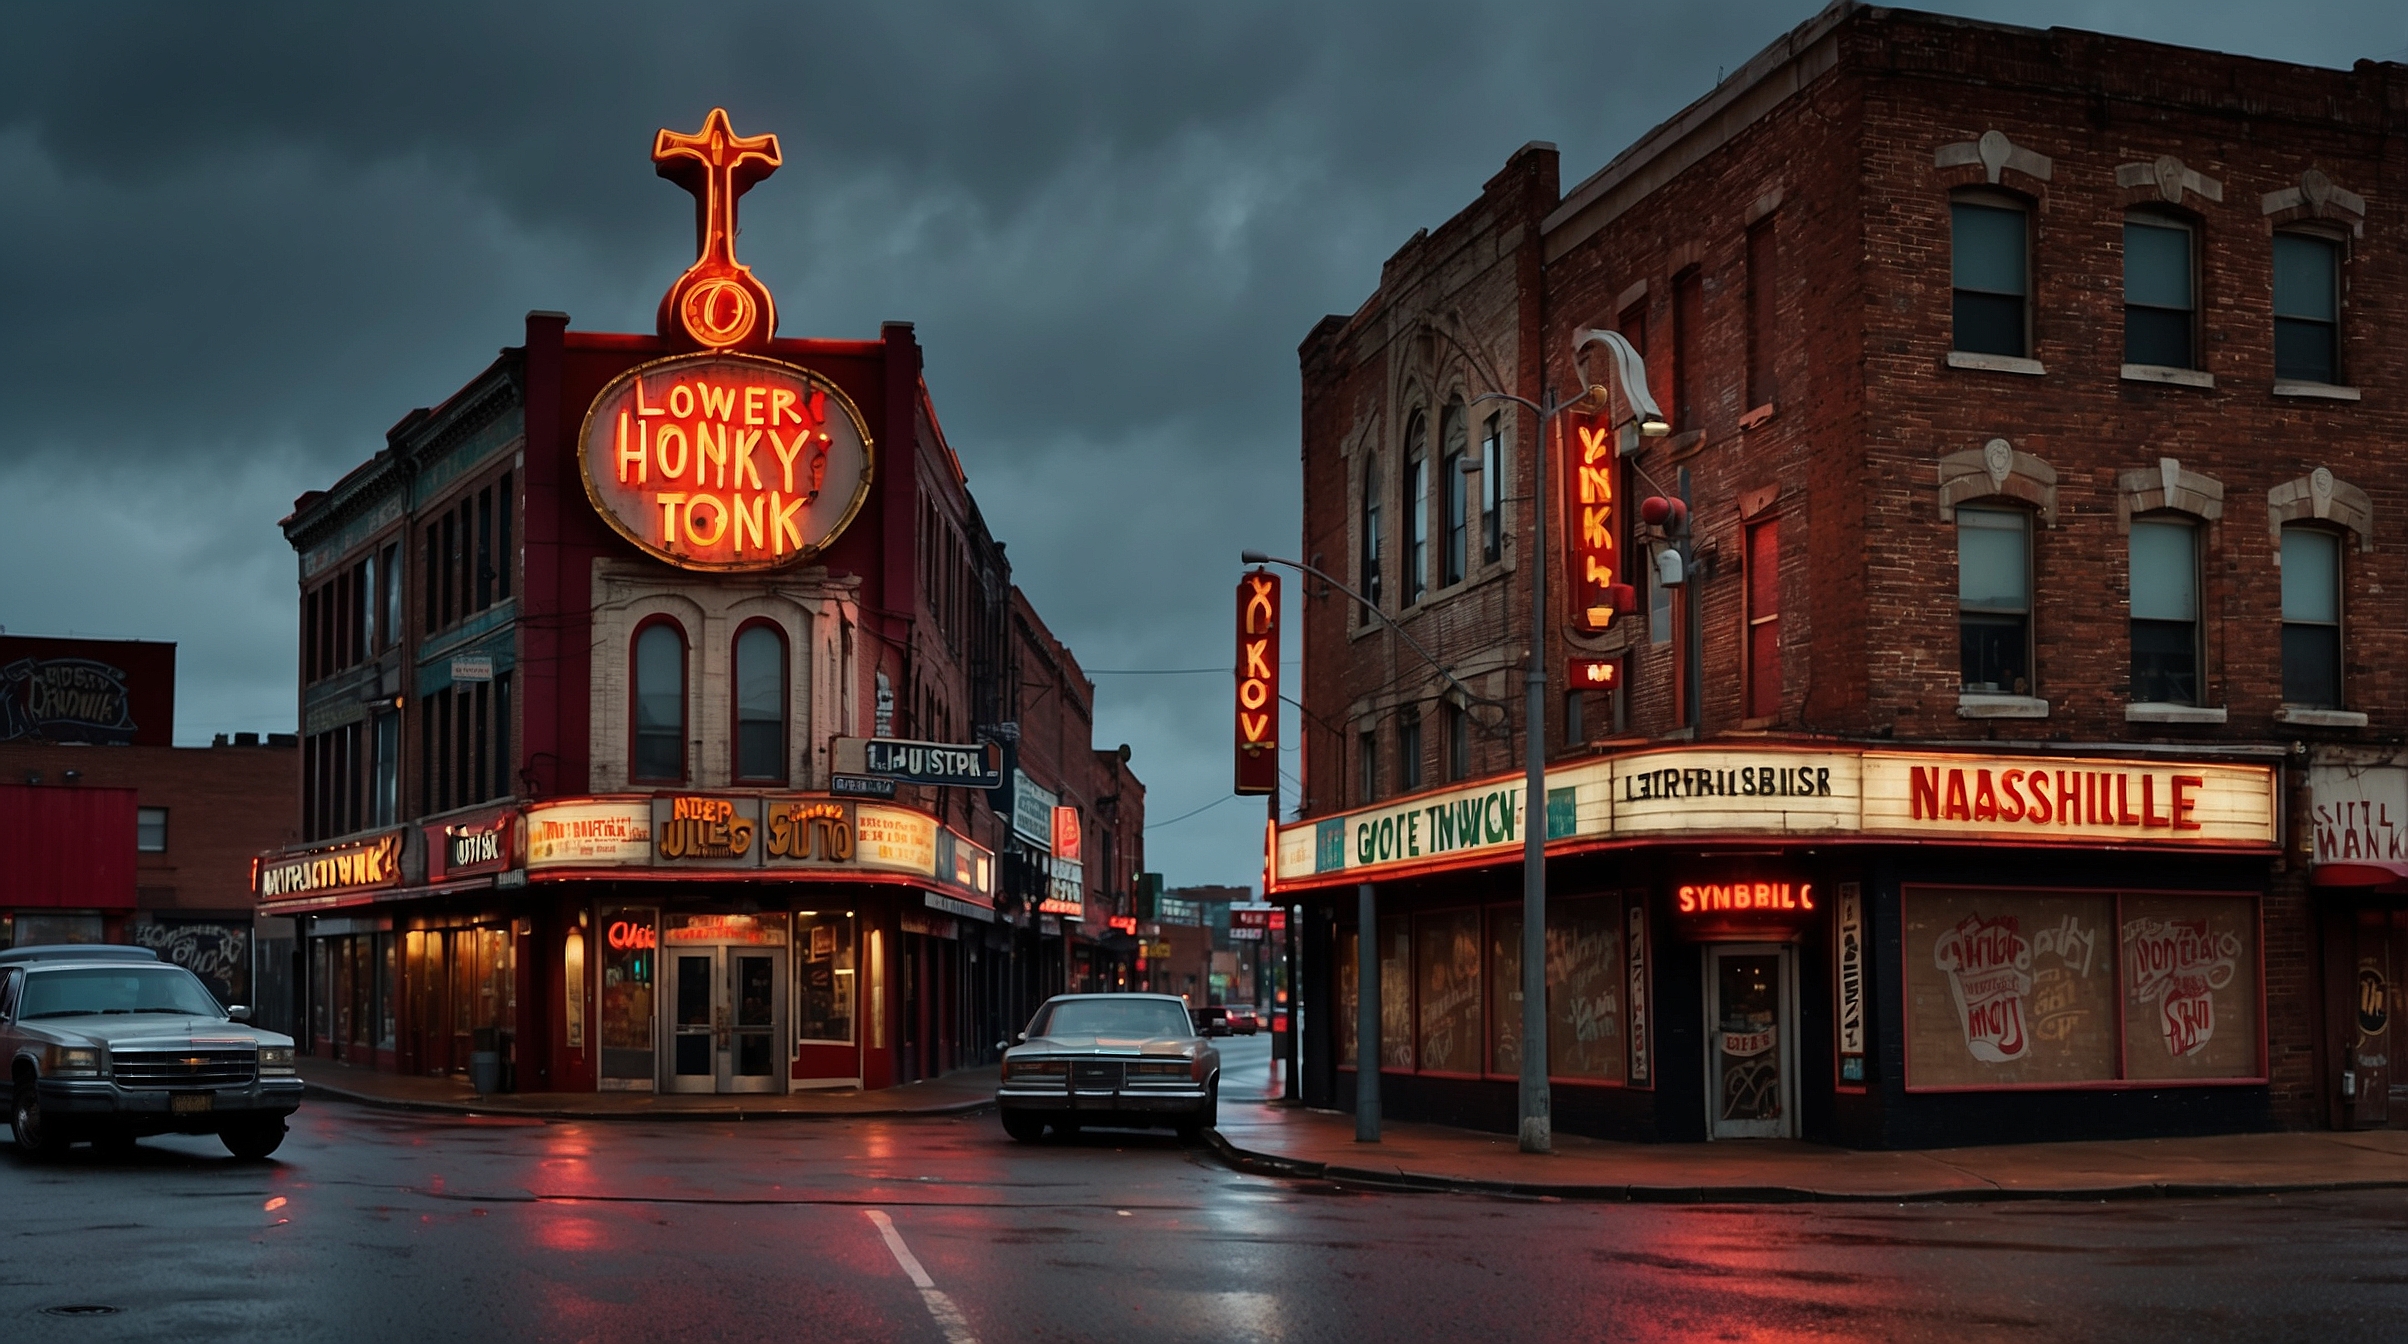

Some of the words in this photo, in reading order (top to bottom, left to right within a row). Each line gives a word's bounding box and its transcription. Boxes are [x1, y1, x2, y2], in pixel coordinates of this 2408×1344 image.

[635, 375, 802, 426] LOWER
[619, 411, 810, 493] HONKY
[657, 491, 808, 556] TONK
